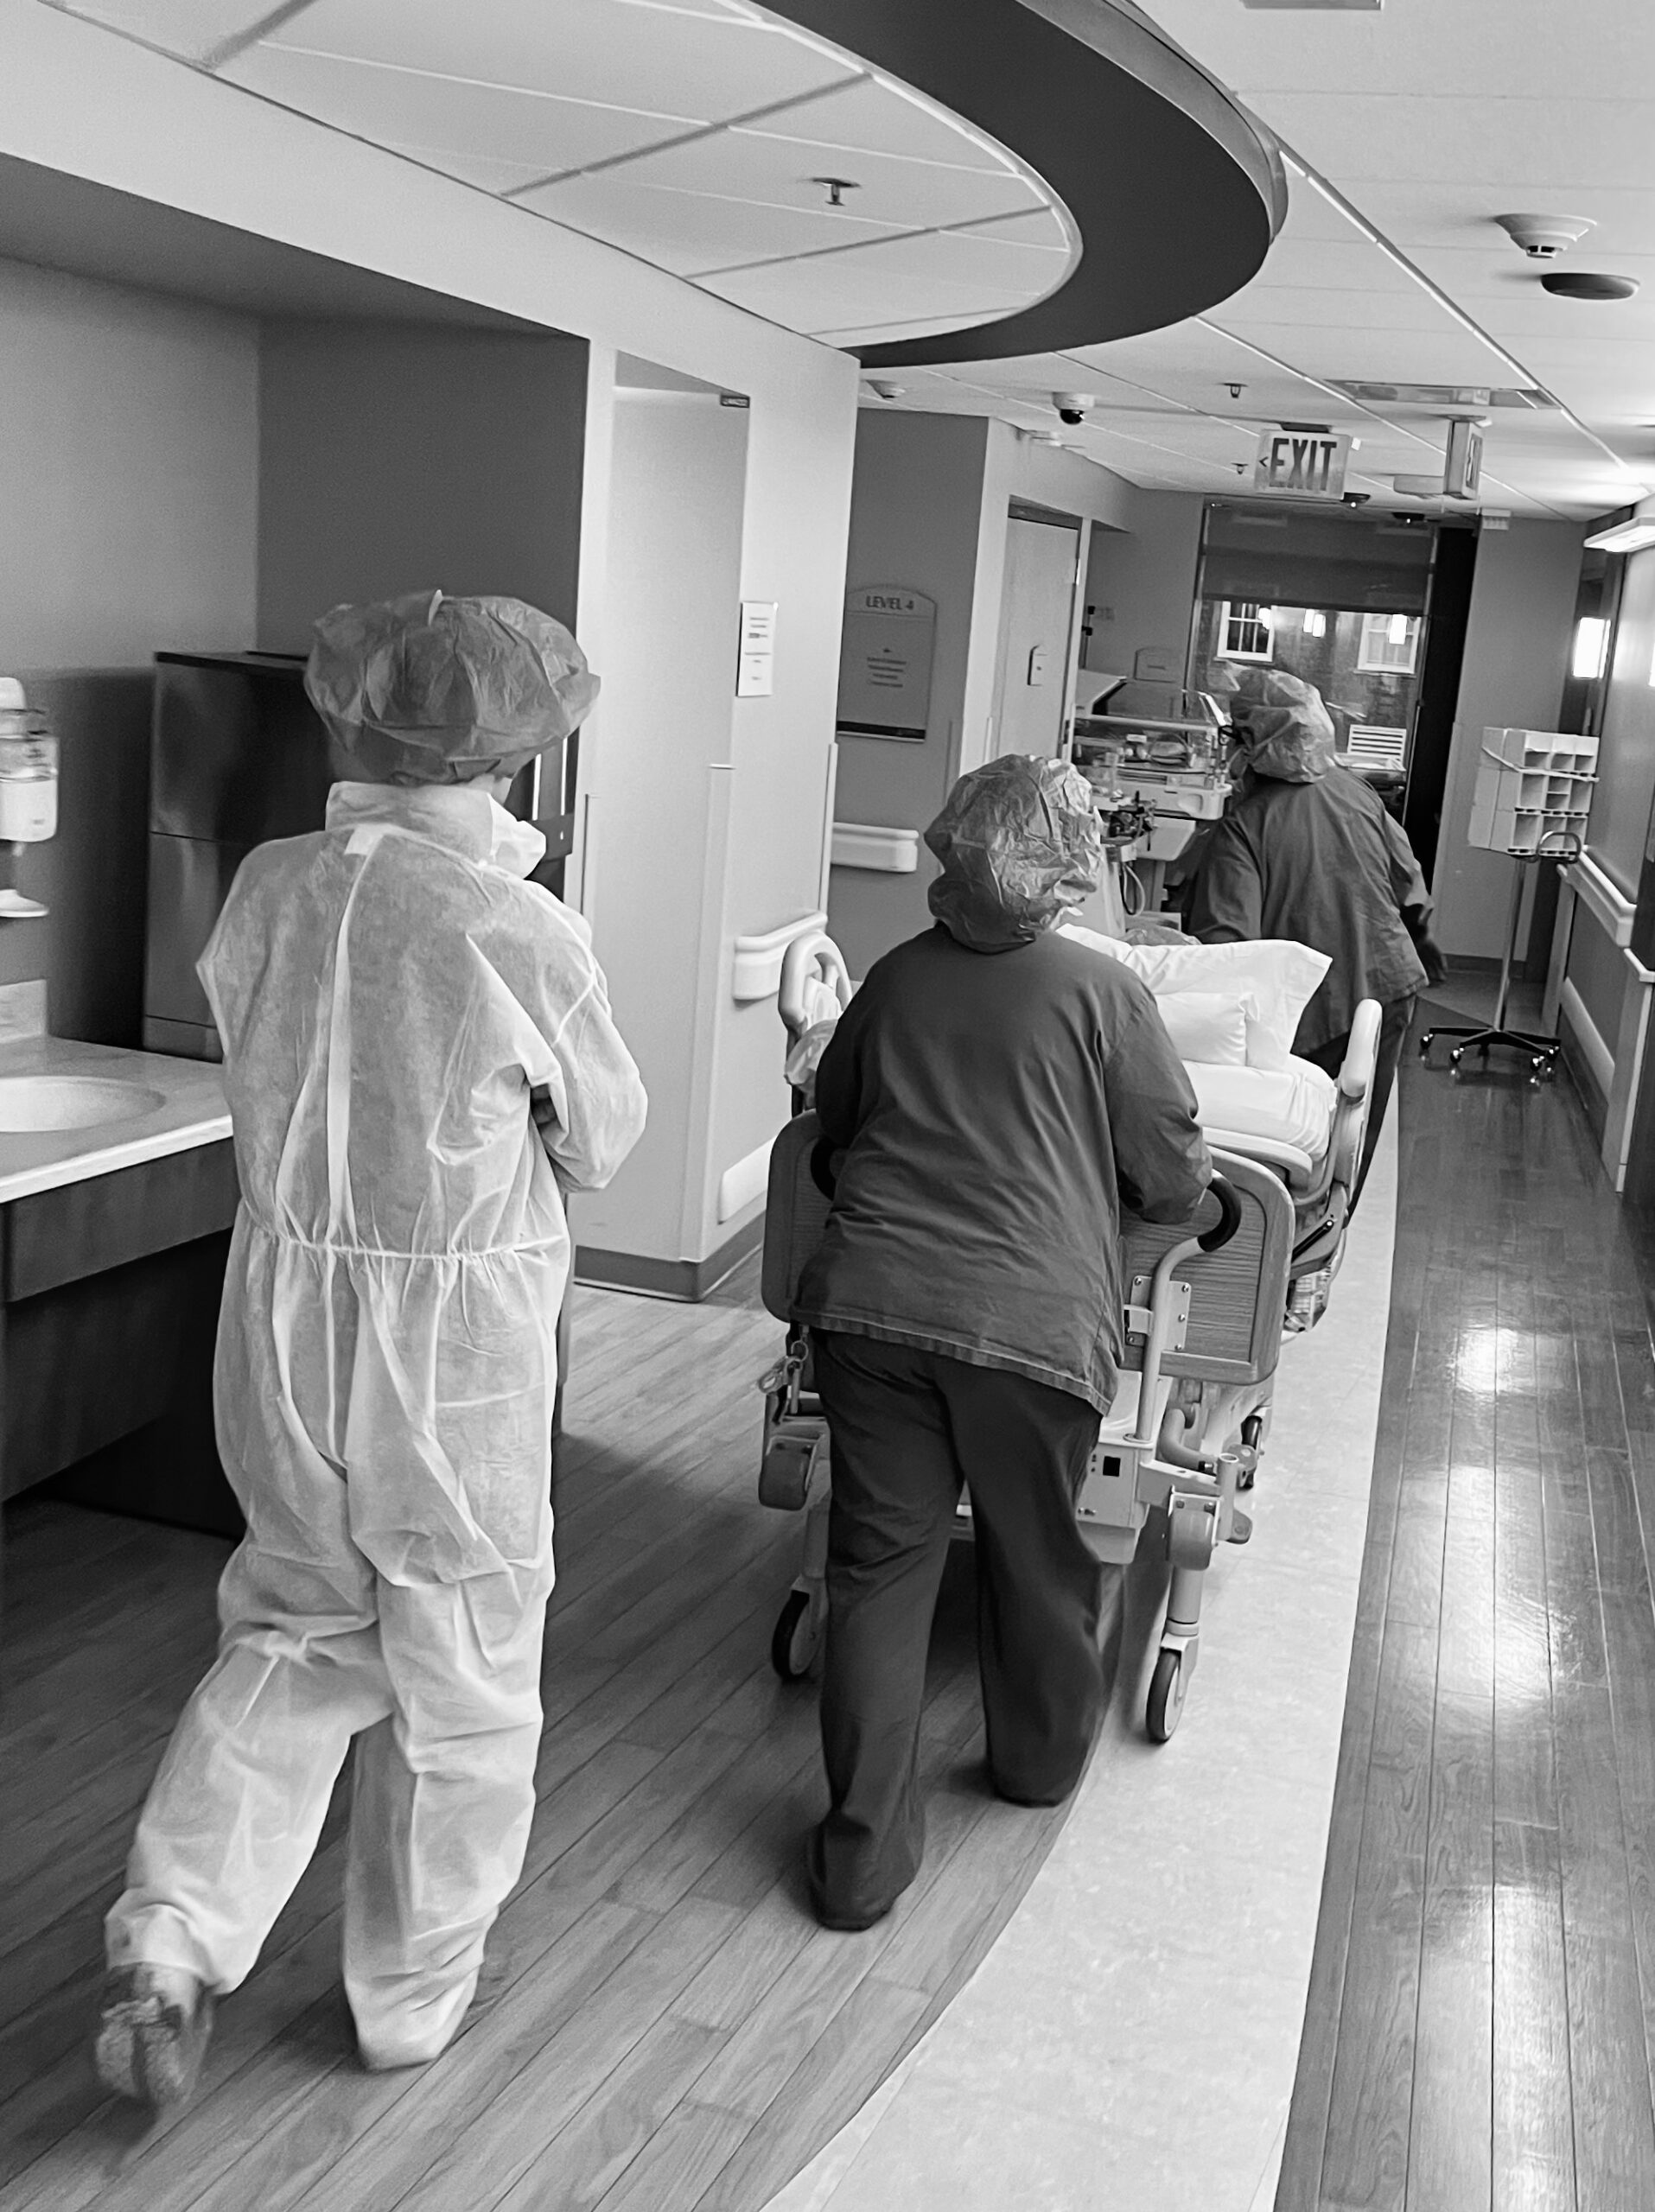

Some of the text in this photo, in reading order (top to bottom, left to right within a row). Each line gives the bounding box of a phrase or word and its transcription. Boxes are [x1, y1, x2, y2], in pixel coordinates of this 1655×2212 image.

[1269, 437, 1337, 492] EXIT
[866, 595, 914, 610] LEVEL 4
